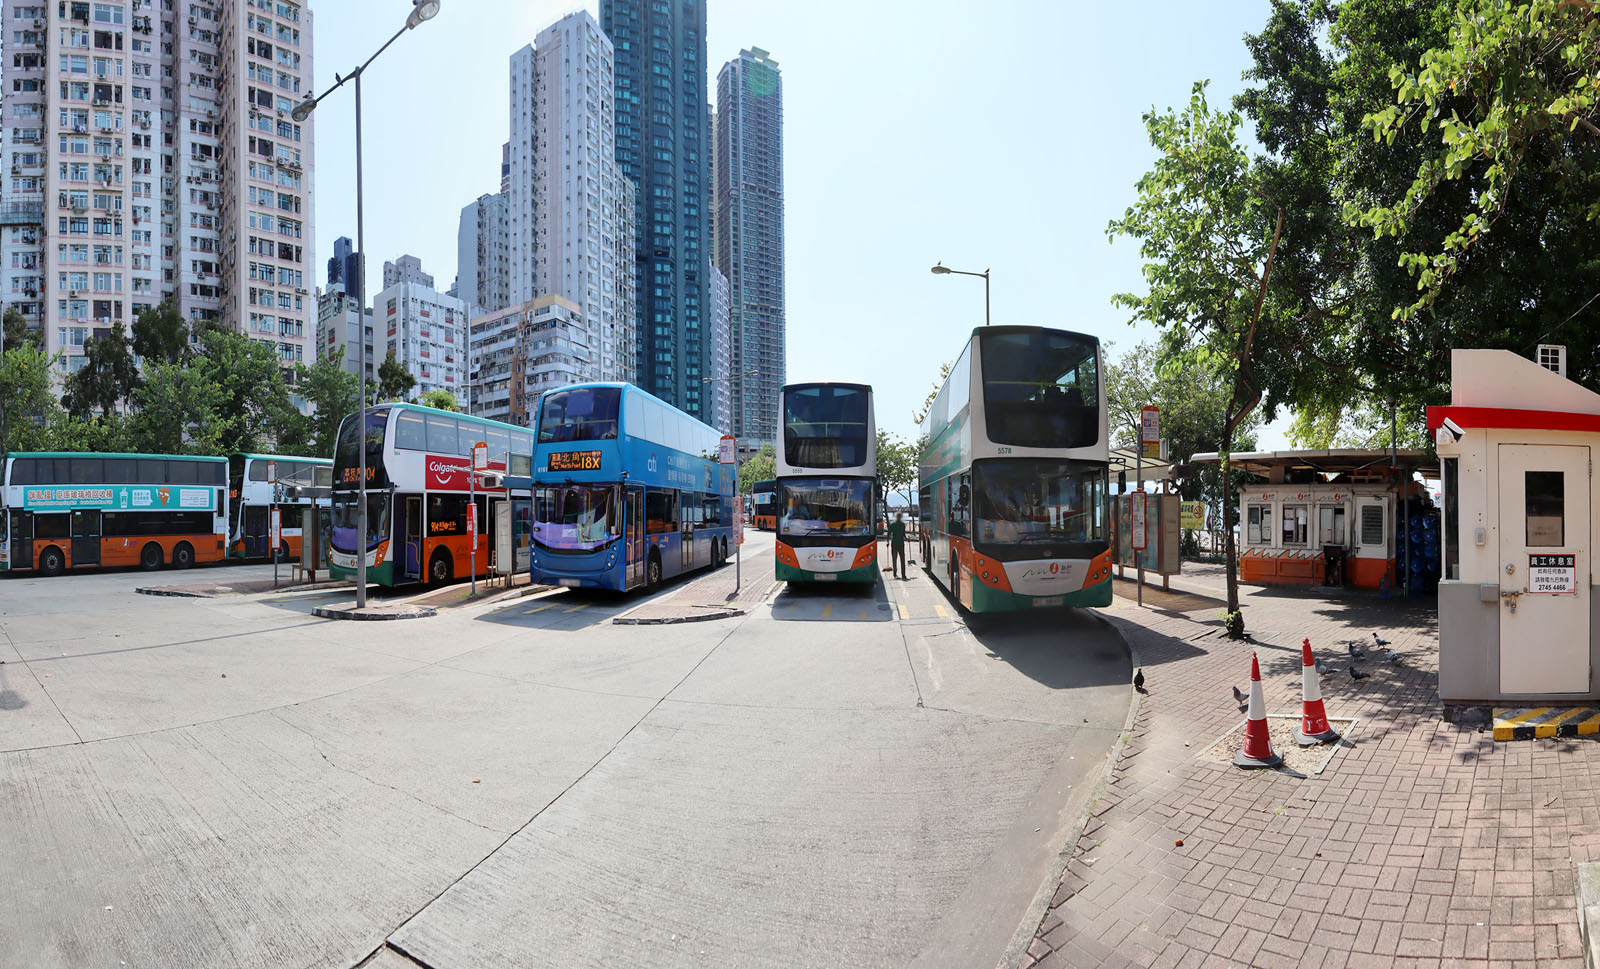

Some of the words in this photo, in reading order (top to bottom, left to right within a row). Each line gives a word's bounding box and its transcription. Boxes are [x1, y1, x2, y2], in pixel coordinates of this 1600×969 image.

[429, 461, 458, 475] Colgate
[581, 456, 600, 469] 18X
[1531, 557, 1574, 566] 員工休息室
